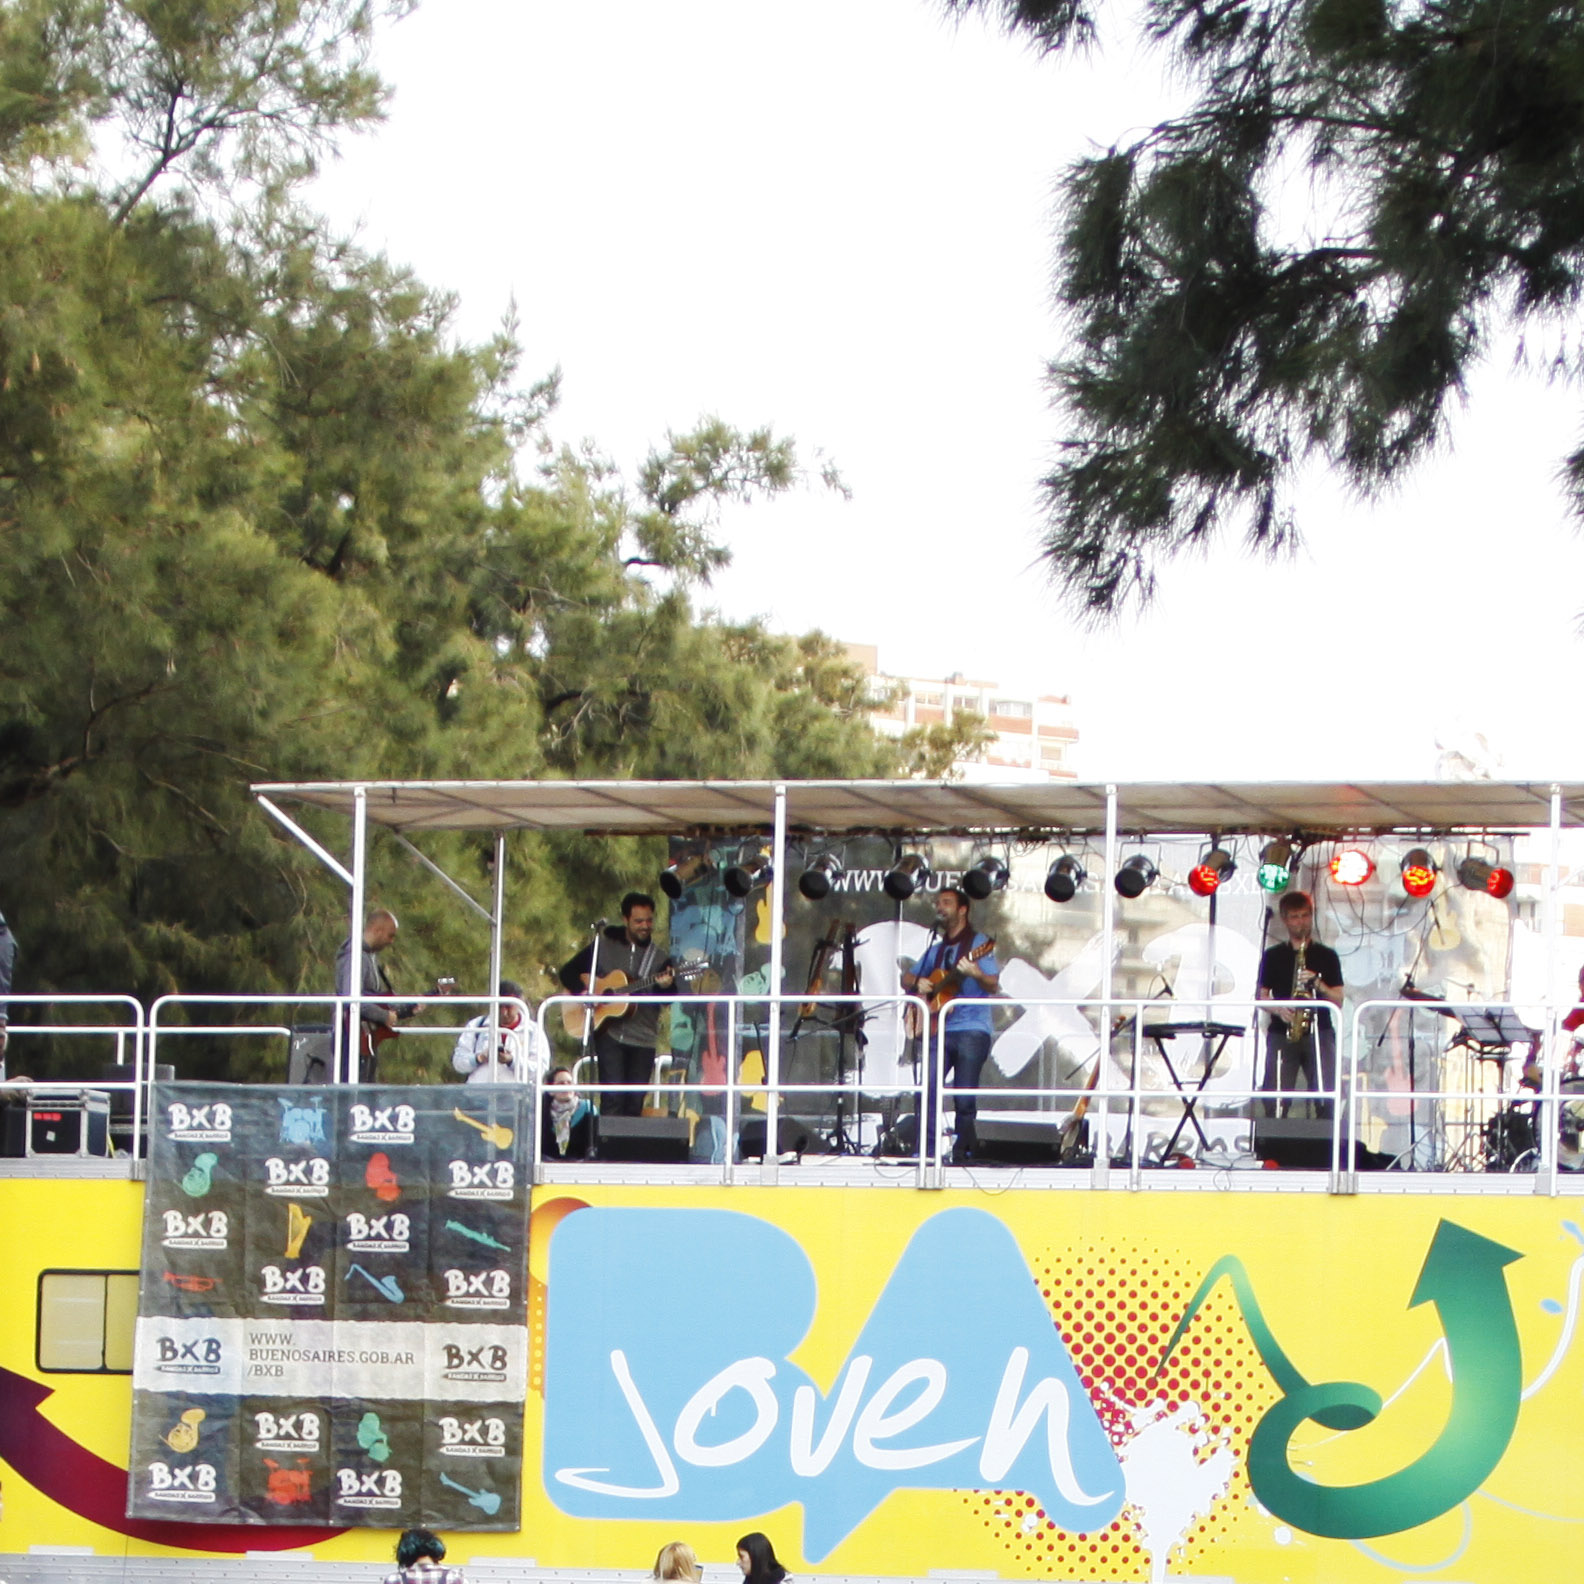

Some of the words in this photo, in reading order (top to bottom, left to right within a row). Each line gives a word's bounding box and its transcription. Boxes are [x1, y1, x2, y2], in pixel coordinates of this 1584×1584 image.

[249, 1333, 296, 1346] WWW.
[248, 1348, 415, 1365] BUENOSAIRES.GOB.AR
[247, 1364, 285, 1377] /BXB
